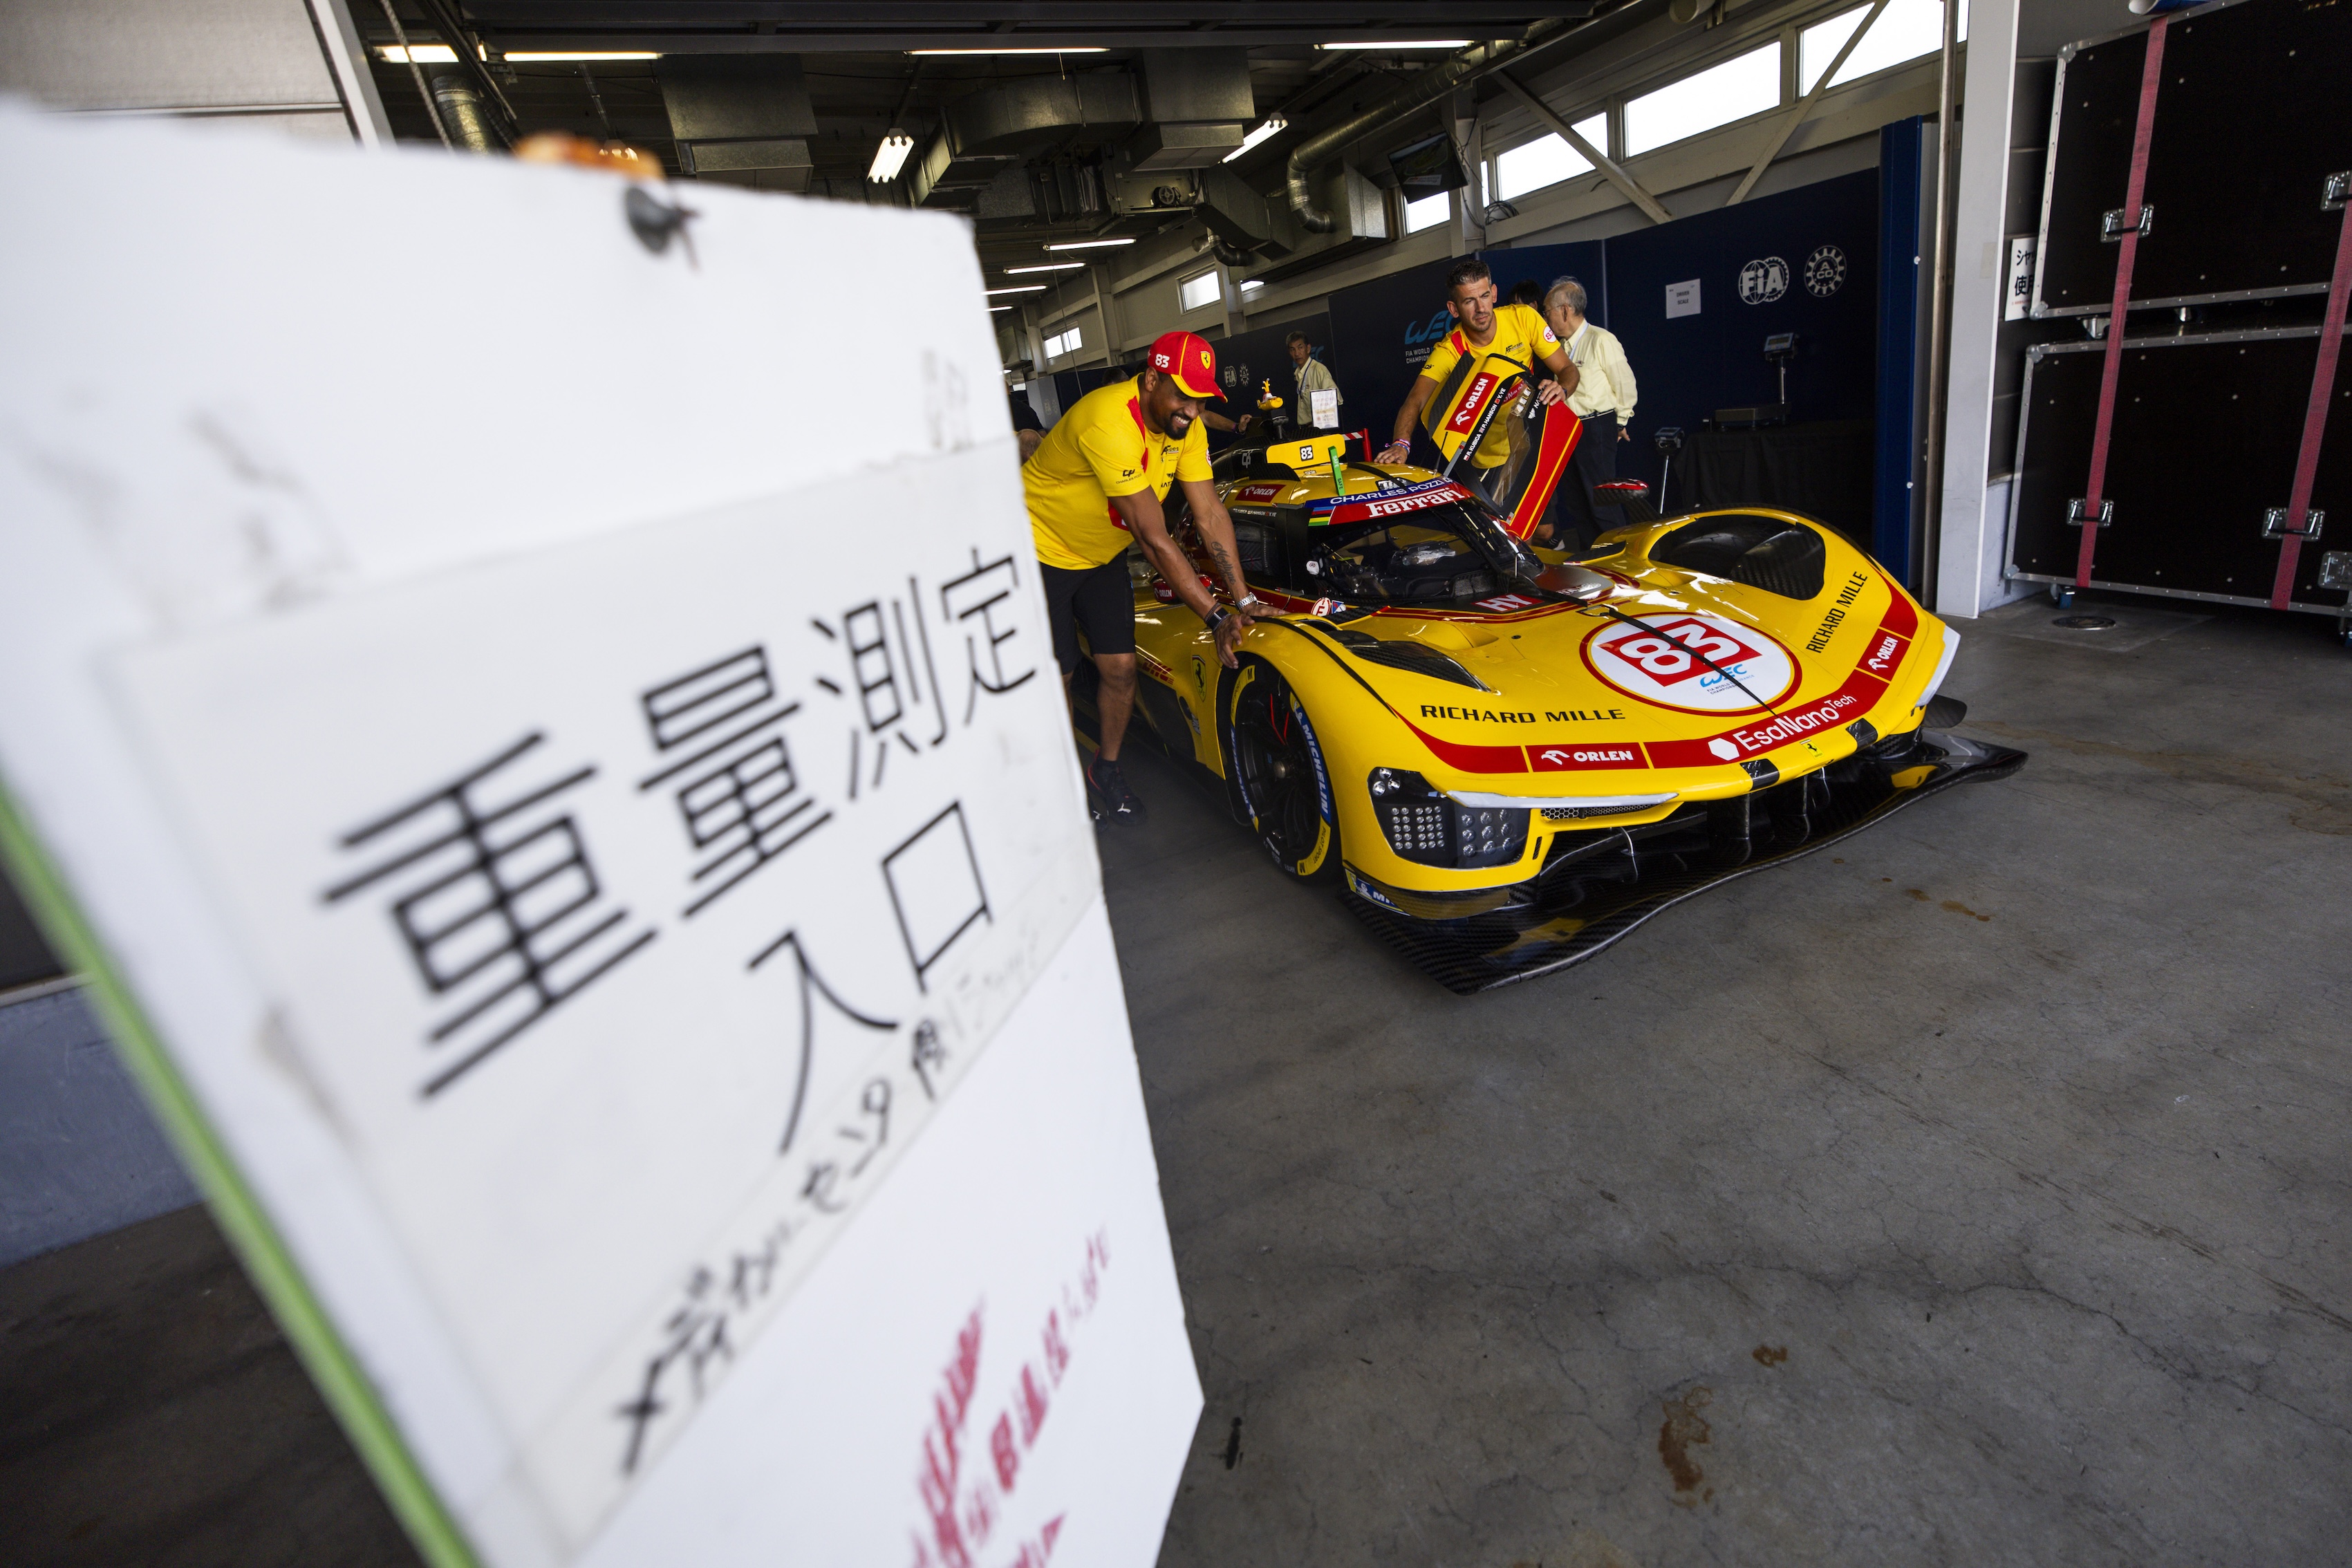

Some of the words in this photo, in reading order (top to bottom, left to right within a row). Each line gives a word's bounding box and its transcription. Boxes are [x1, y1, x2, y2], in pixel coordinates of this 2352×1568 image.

[1155, 353, 1170, 368] 83
[1413, 347, 1430, 355] WORLD
[1466, 378, 1488, 409] ORLEN
[1300, 447, 1313, 460] 83
[1330, 489, 1406, 505] CHARLES
[1408, 480, 1445, 492] POZZI
[1365, 487, 1465, 518] Ferrari
[1806, 608, 1846, 653] RICHARD
[1836, 571, 1868, 608] MILLE
[1619, 624, 1741, 675] 83
[1877, 636, 1898, 660] ORLEN
[1247, 668, 1253, 681] M
[1700, 664, 1747, 687] WEC
[1421, 705, 1536, 723] RICHARD
[1545, 709, 1626, 722] MILLE
[1303, 724, 1328, 814] MICHELIN
[1573, 751, 1634, 763] ORLEN
[317, 546, 1038, 1106] 重量測定
[744, 799, 993, 1158] 入口
